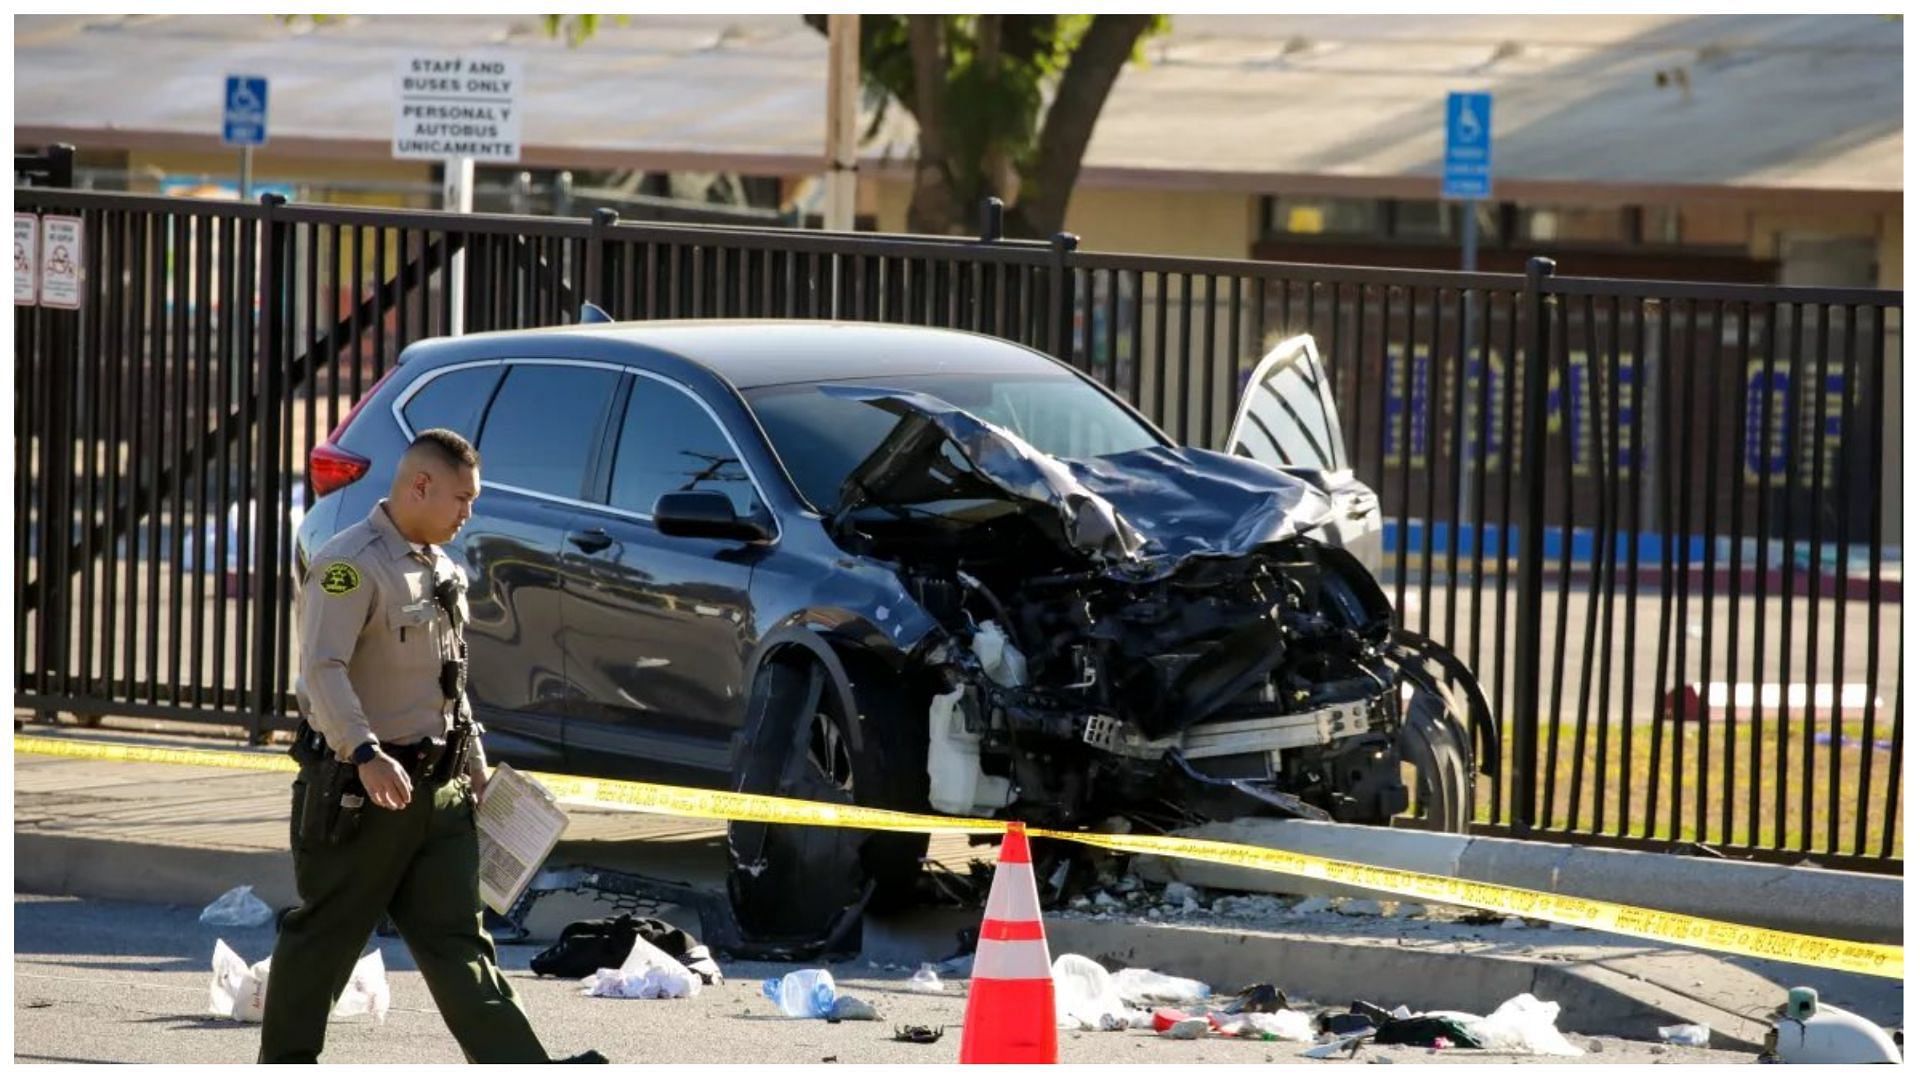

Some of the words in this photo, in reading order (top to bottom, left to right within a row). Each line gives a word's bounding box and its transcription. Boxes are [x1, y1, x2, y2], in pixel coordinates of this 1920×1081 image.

[412, 59, 461, 72] STAFF
[469, 62, 505, 74] AND
[403, 78, 461, 91] BUSES
[466, 81, 511, 92] ONLY
[403, 105, 493, 120] PERSONAL
[501, 109, 510, 121] Y
[416, 123, 497, 137] AUTOBUS
[398, 141, 513, 155] UNICAMENTE
